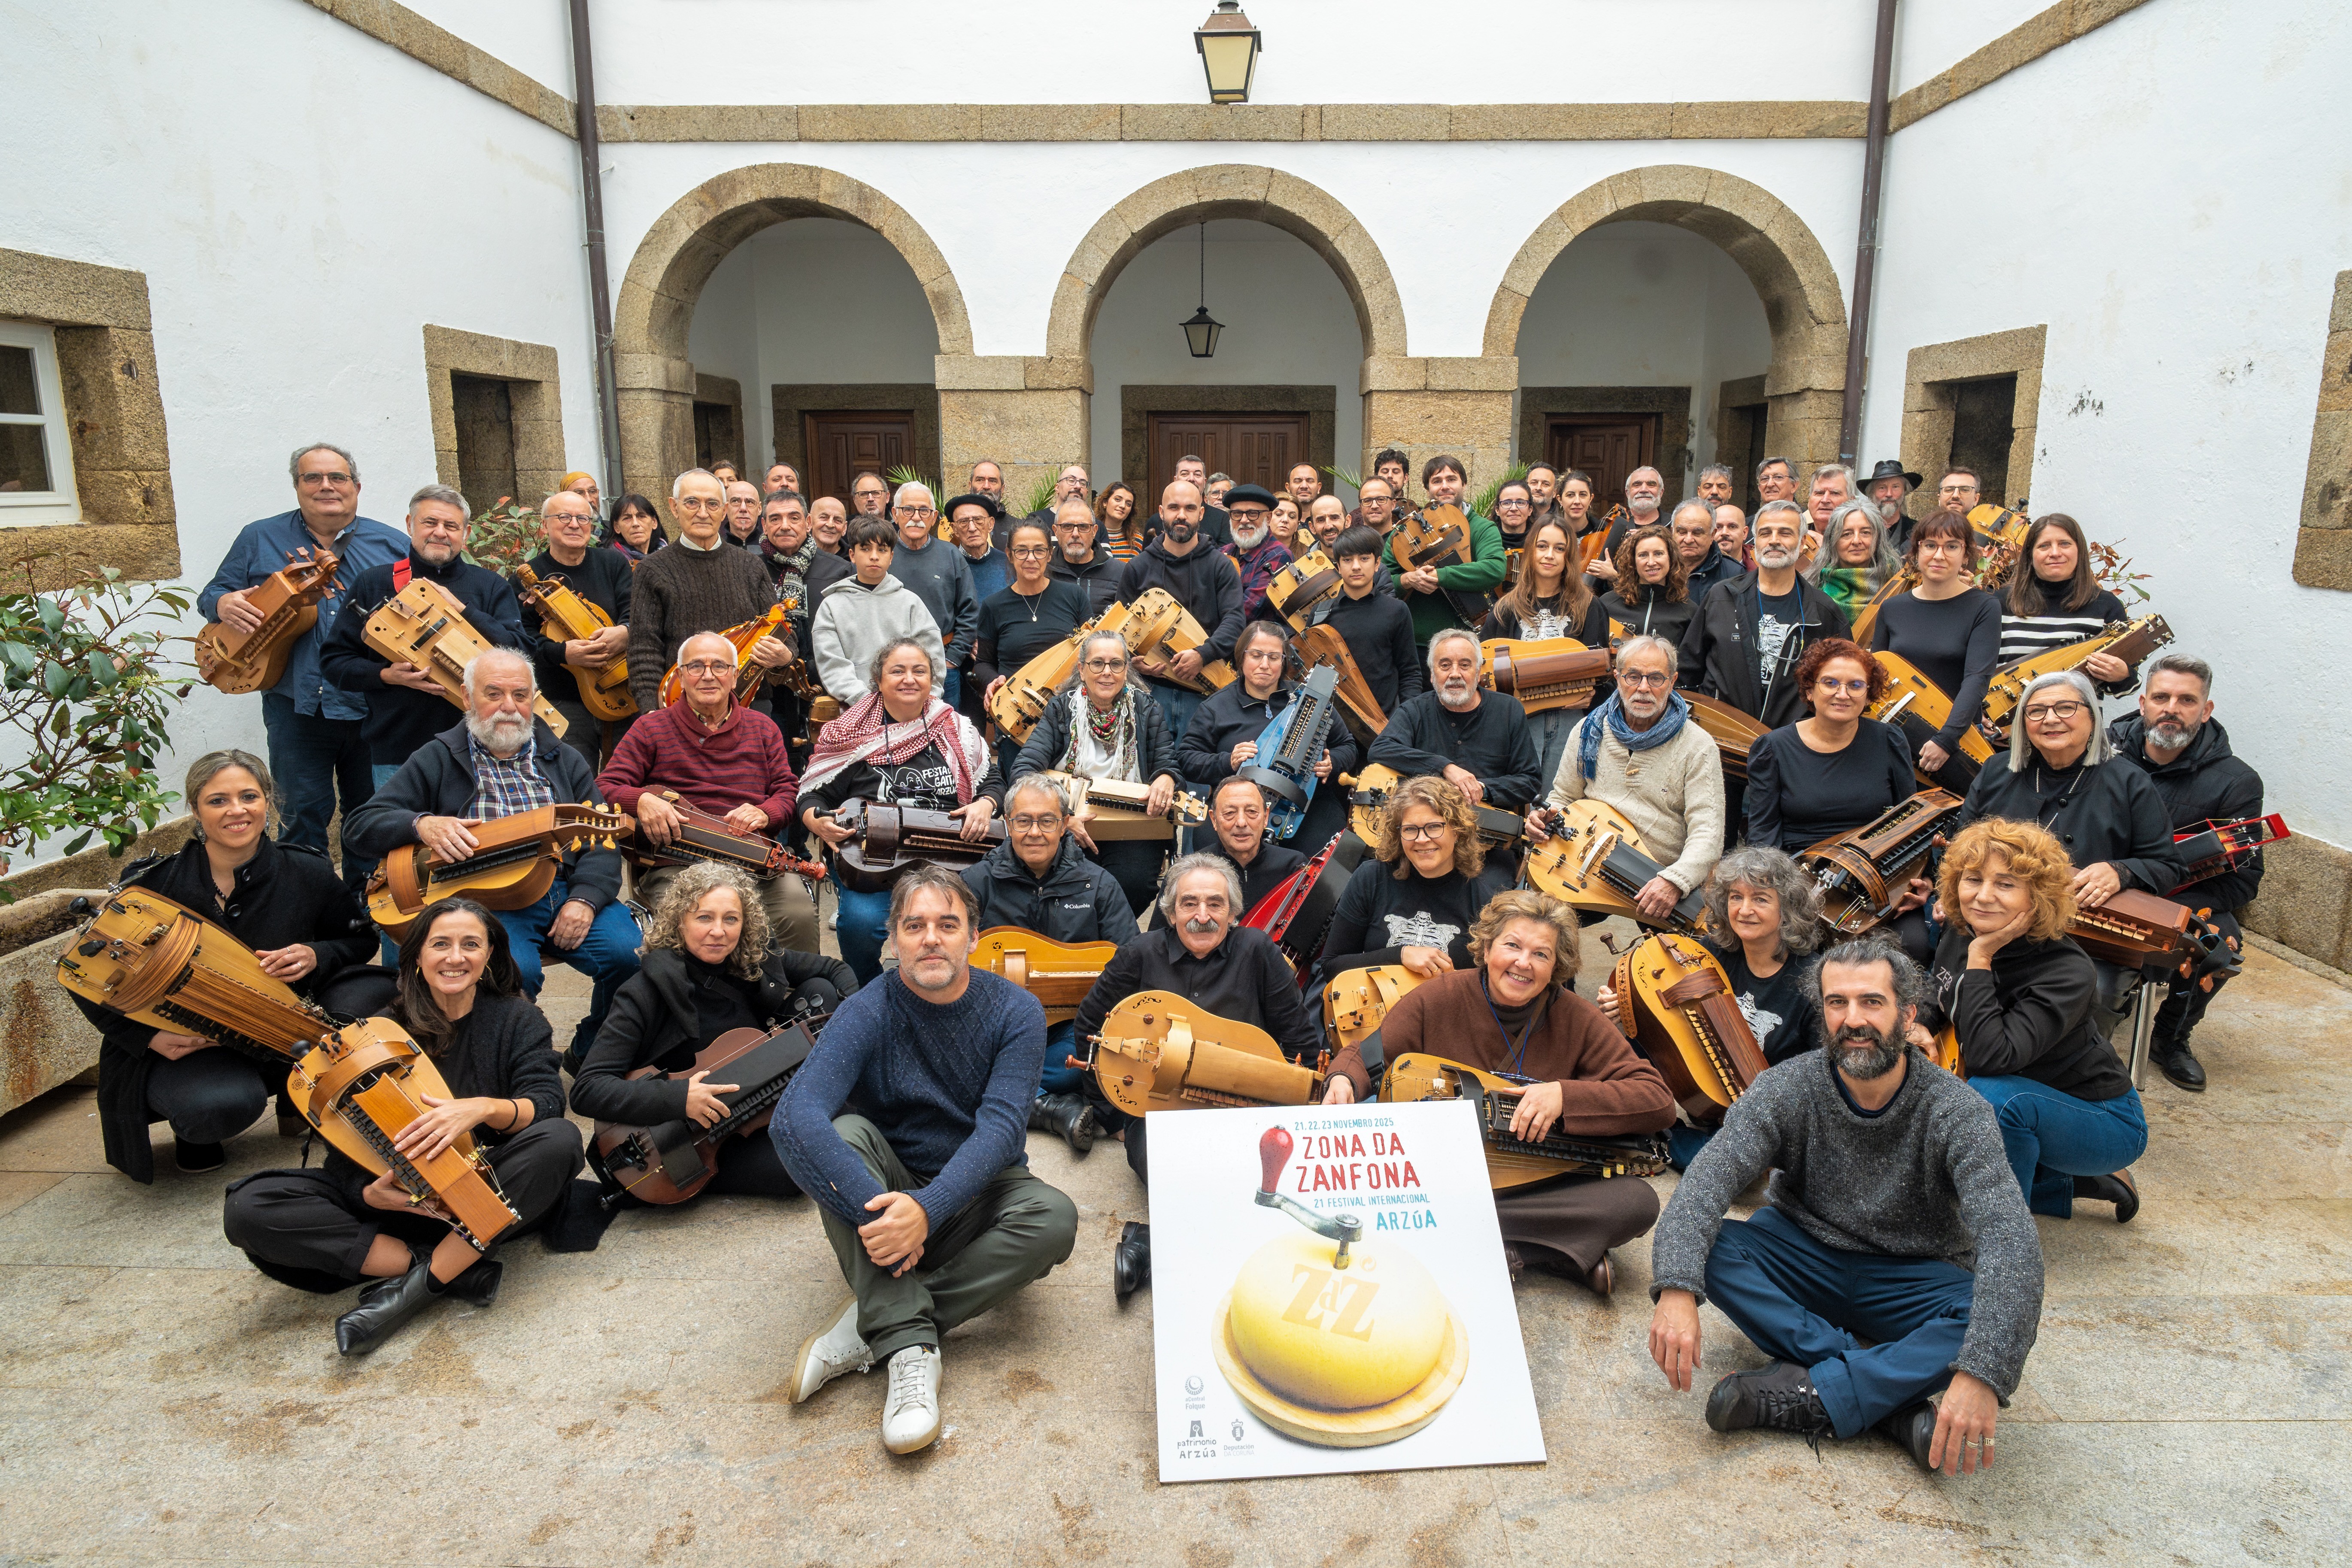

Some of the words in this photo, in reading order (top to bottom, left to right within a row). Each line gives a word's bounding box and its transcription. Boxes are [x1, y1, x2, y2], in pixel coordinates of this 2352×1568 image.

[1322, 1121, 1331, 1129] 23
[1333, 1119, 1372, 1128] NOVEMBRO
[1375, 1118, 1394, 1127] 2025
[1303, 1134, 1366, 1159] ZONA
[1373, 1133, 1405, 1156] DA
[1296, 1161, 1420, 1192] ZANFONA
[1314, 1199, 1324, 1208] 21
[1328, 1197, 1366, 1207] FESTIVAL
[1369, 1193, 1430, 1205] INTERNACIONAL
[1377, 1210, 1437, 1231] ARZÚA
[1178, 1438, 1217, 1449] patrimonio
